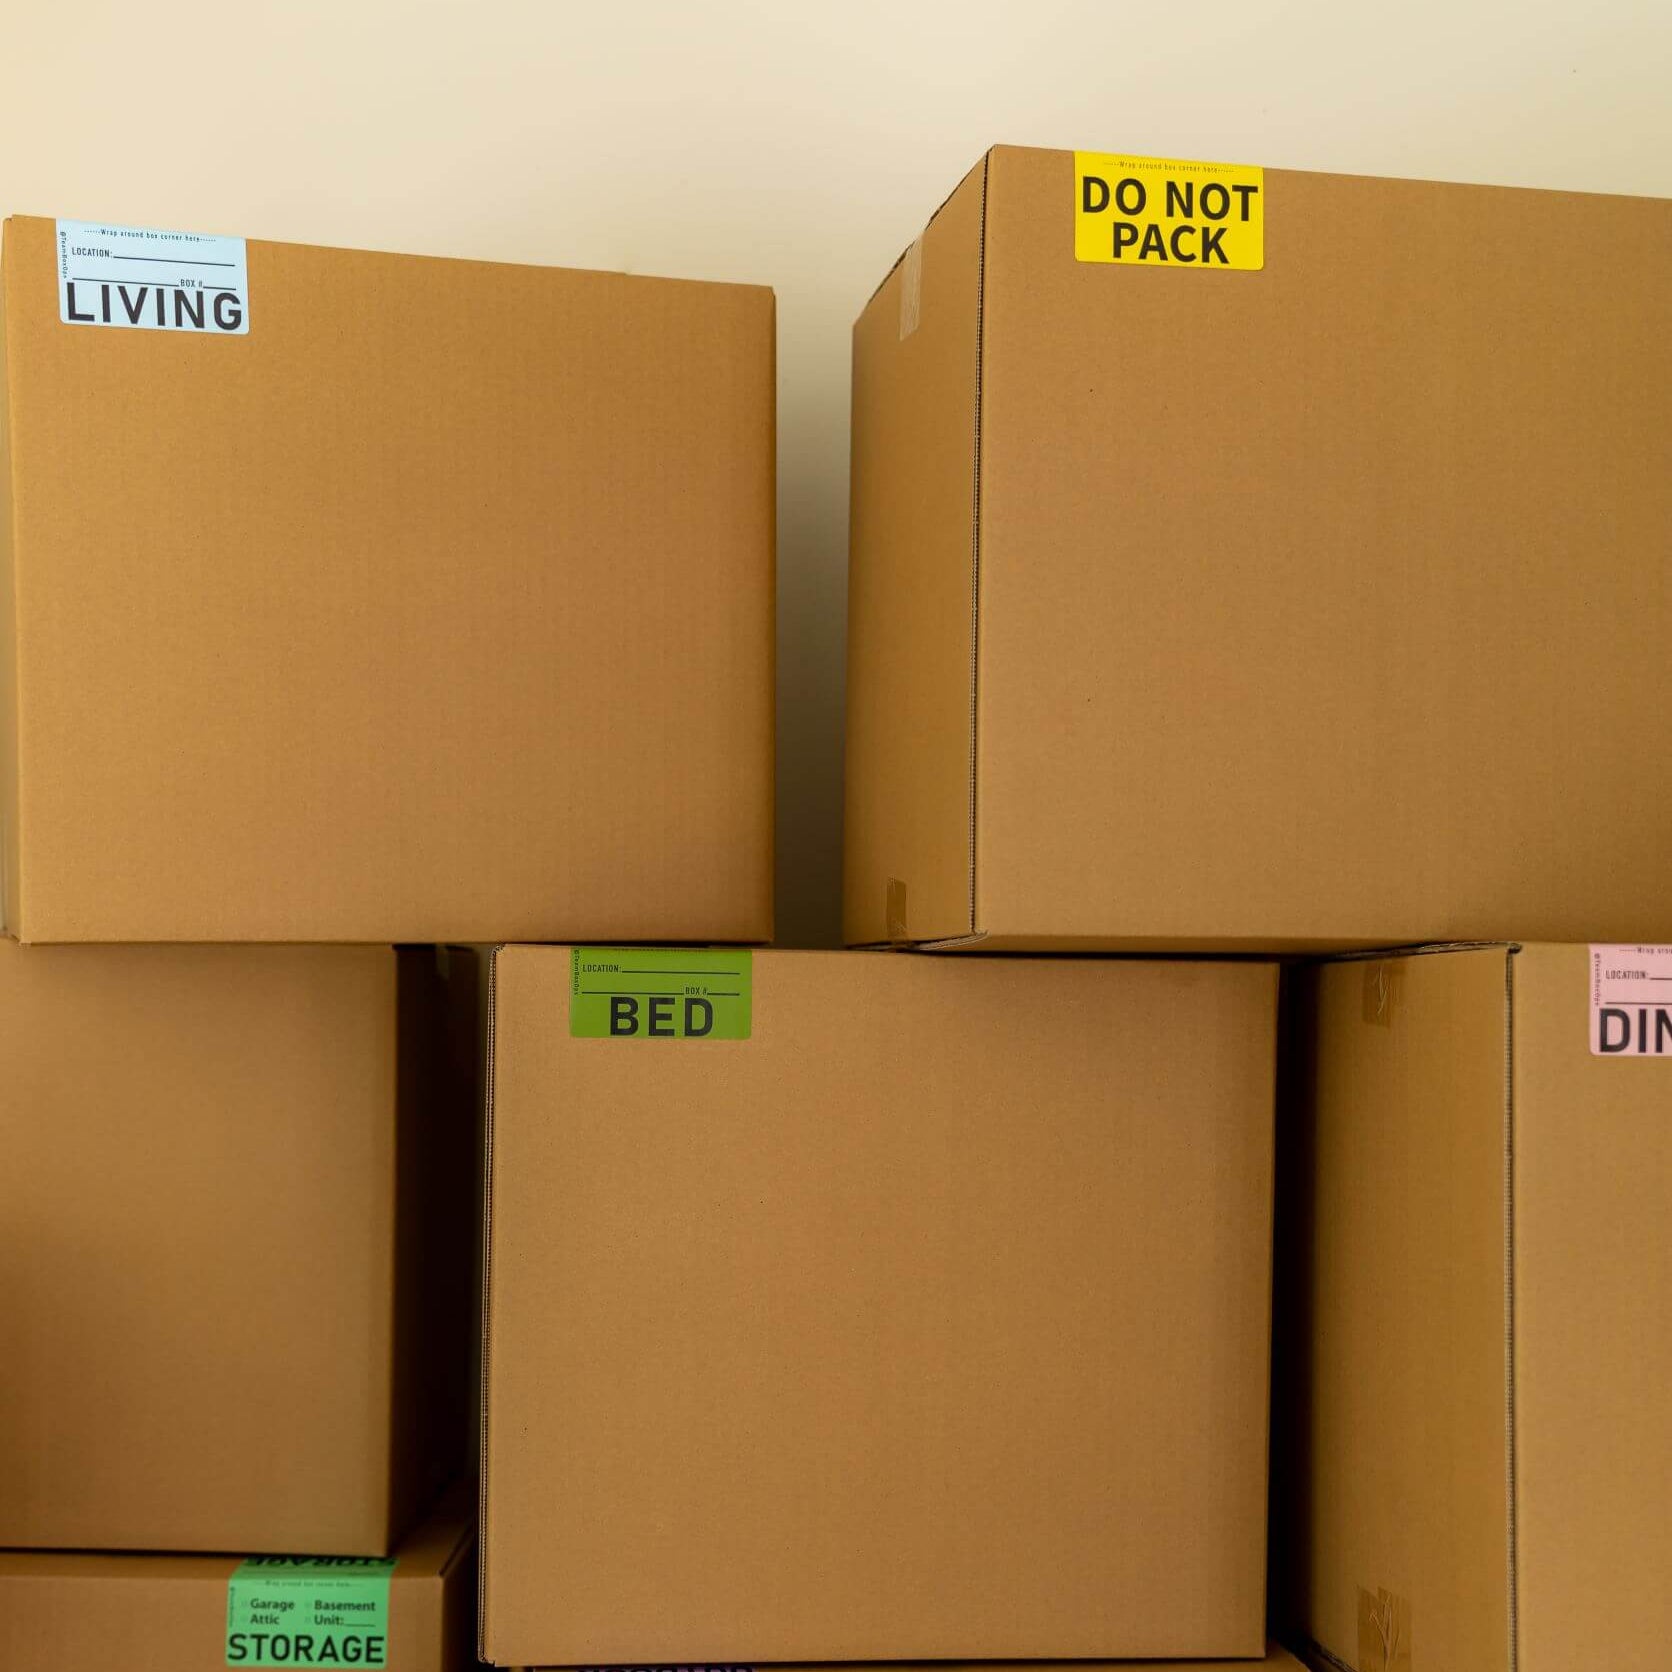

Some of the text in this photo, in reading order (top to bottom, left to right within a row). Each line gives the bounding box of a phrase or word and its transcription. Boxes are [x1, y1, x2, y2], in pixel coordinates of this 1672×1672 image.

[1082, 176, 1258, 222] DO NOT
[1113, 222, 1230, 264] PACK
[72, 247, 113, 258] LOCATION:
[180, 279, 196, 288] BOX
[67, 282, 242, 331] LIVING
[583, 964, 621, 973] LOCATION:
[1605, 970, 1649, 980] LOCATION:
[685, 987, 700, 995] BOX
[610, 996, 713, 1037] BED
[250, 1598, 376, 1612] Garage Basement
[250, 1614, 344, 1626] Attic Unit:
[227, 1633, 385, 1663] STORAGE
